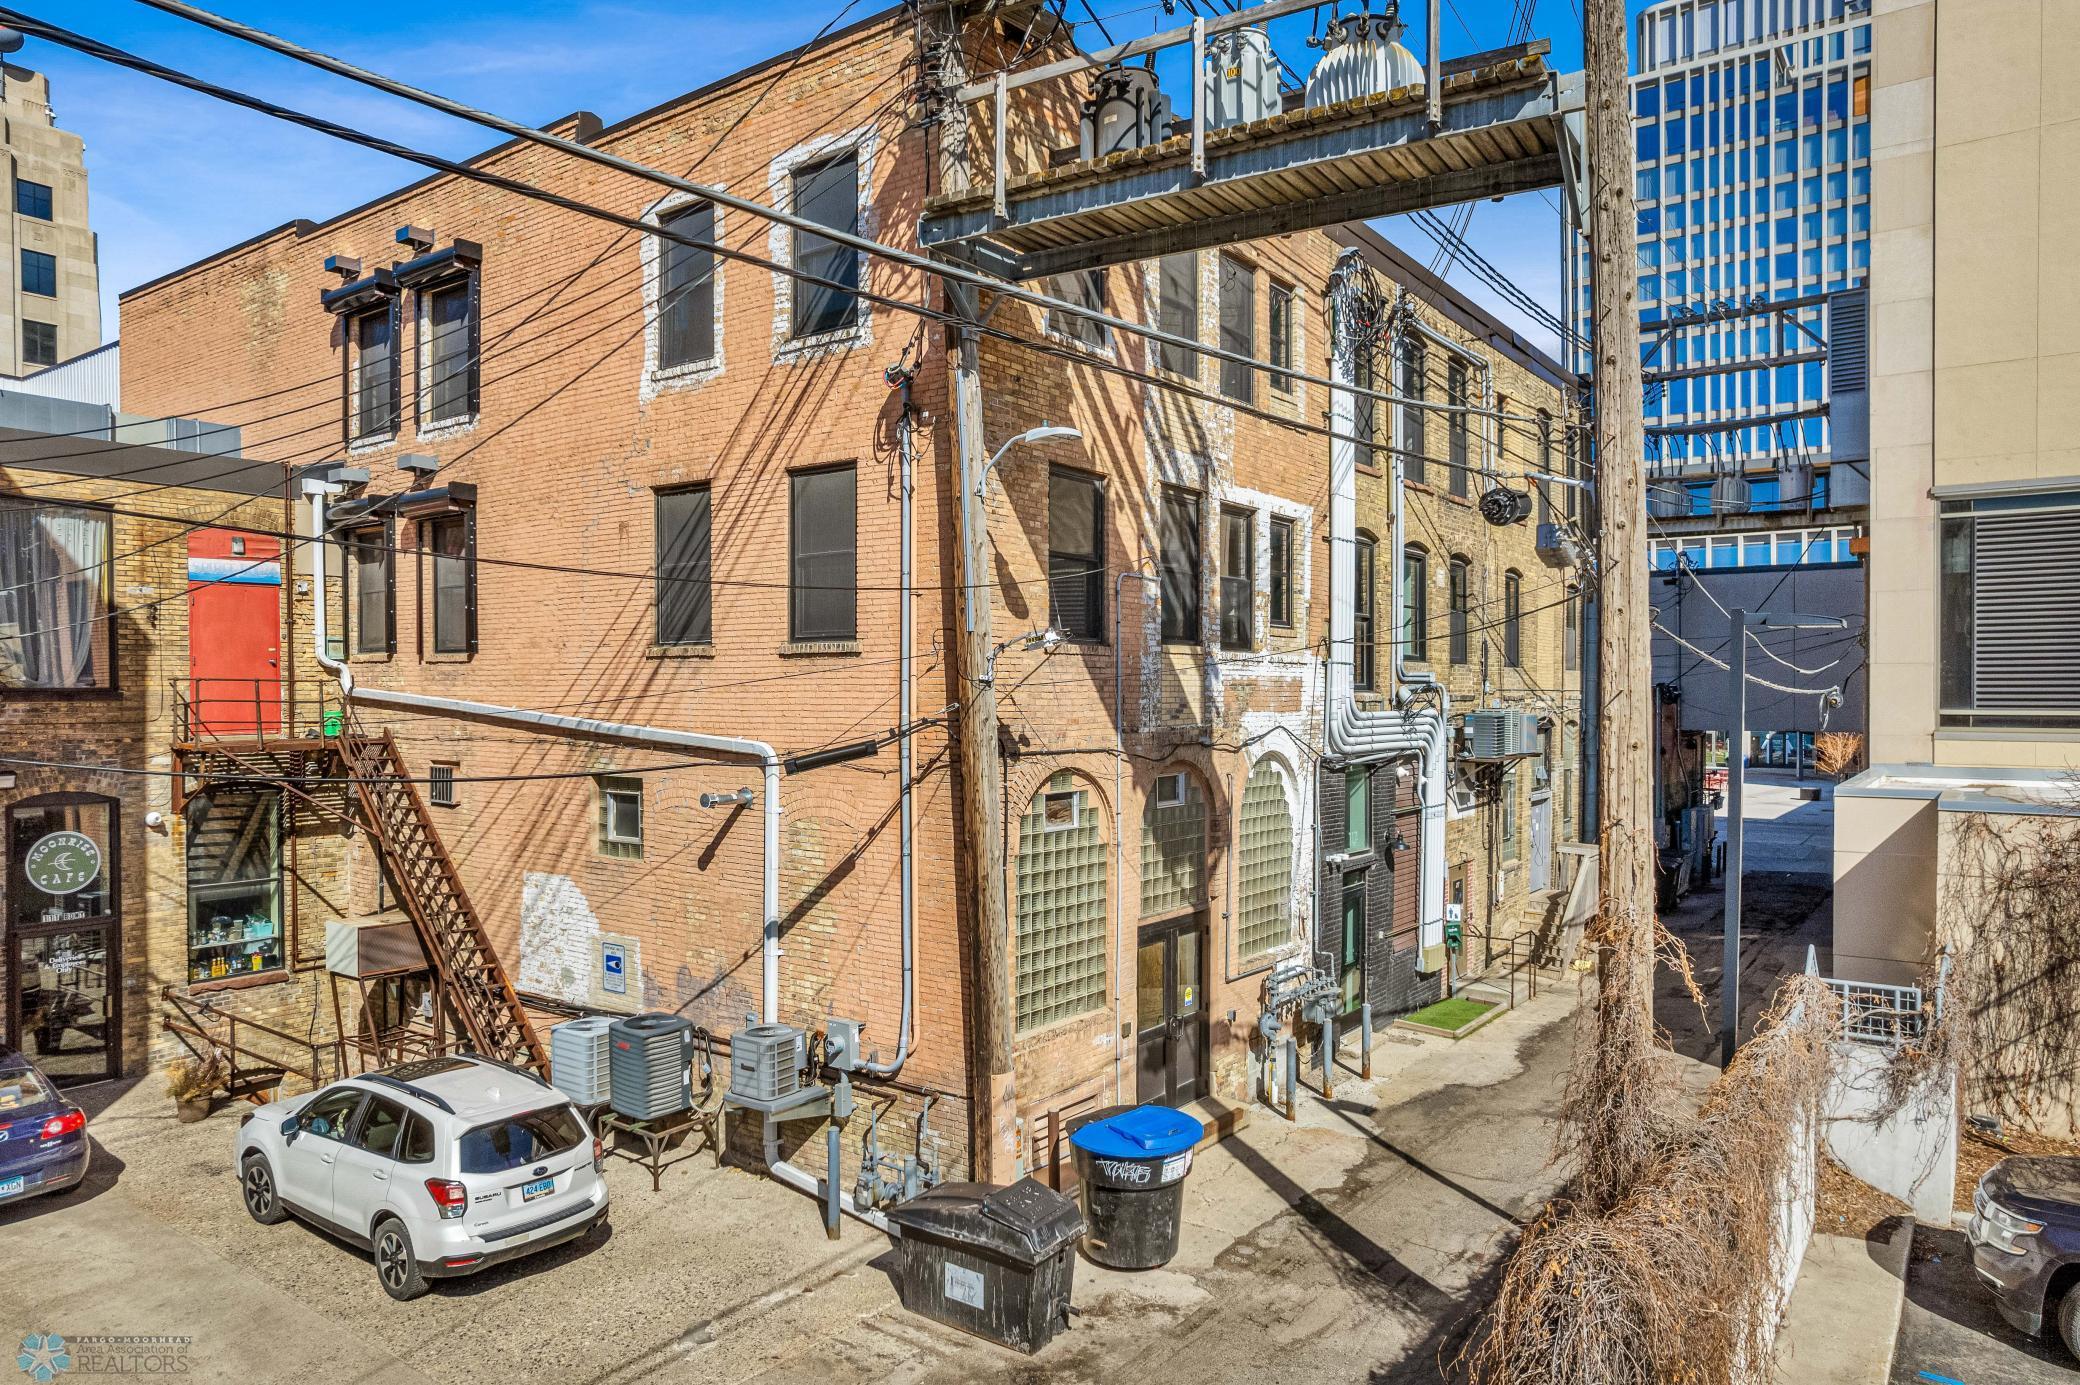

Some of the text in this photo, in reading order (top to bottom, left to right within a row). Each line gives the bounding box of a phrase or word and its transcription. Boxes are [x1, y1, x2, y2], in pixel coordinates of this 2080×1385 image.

[1227, 67, 1241, 78] 100
[32, 837, 95, 862] MOONRISE
[40, 871, 85, 885] CAFE
[474, 1191, 502, 1201] SUBARU
